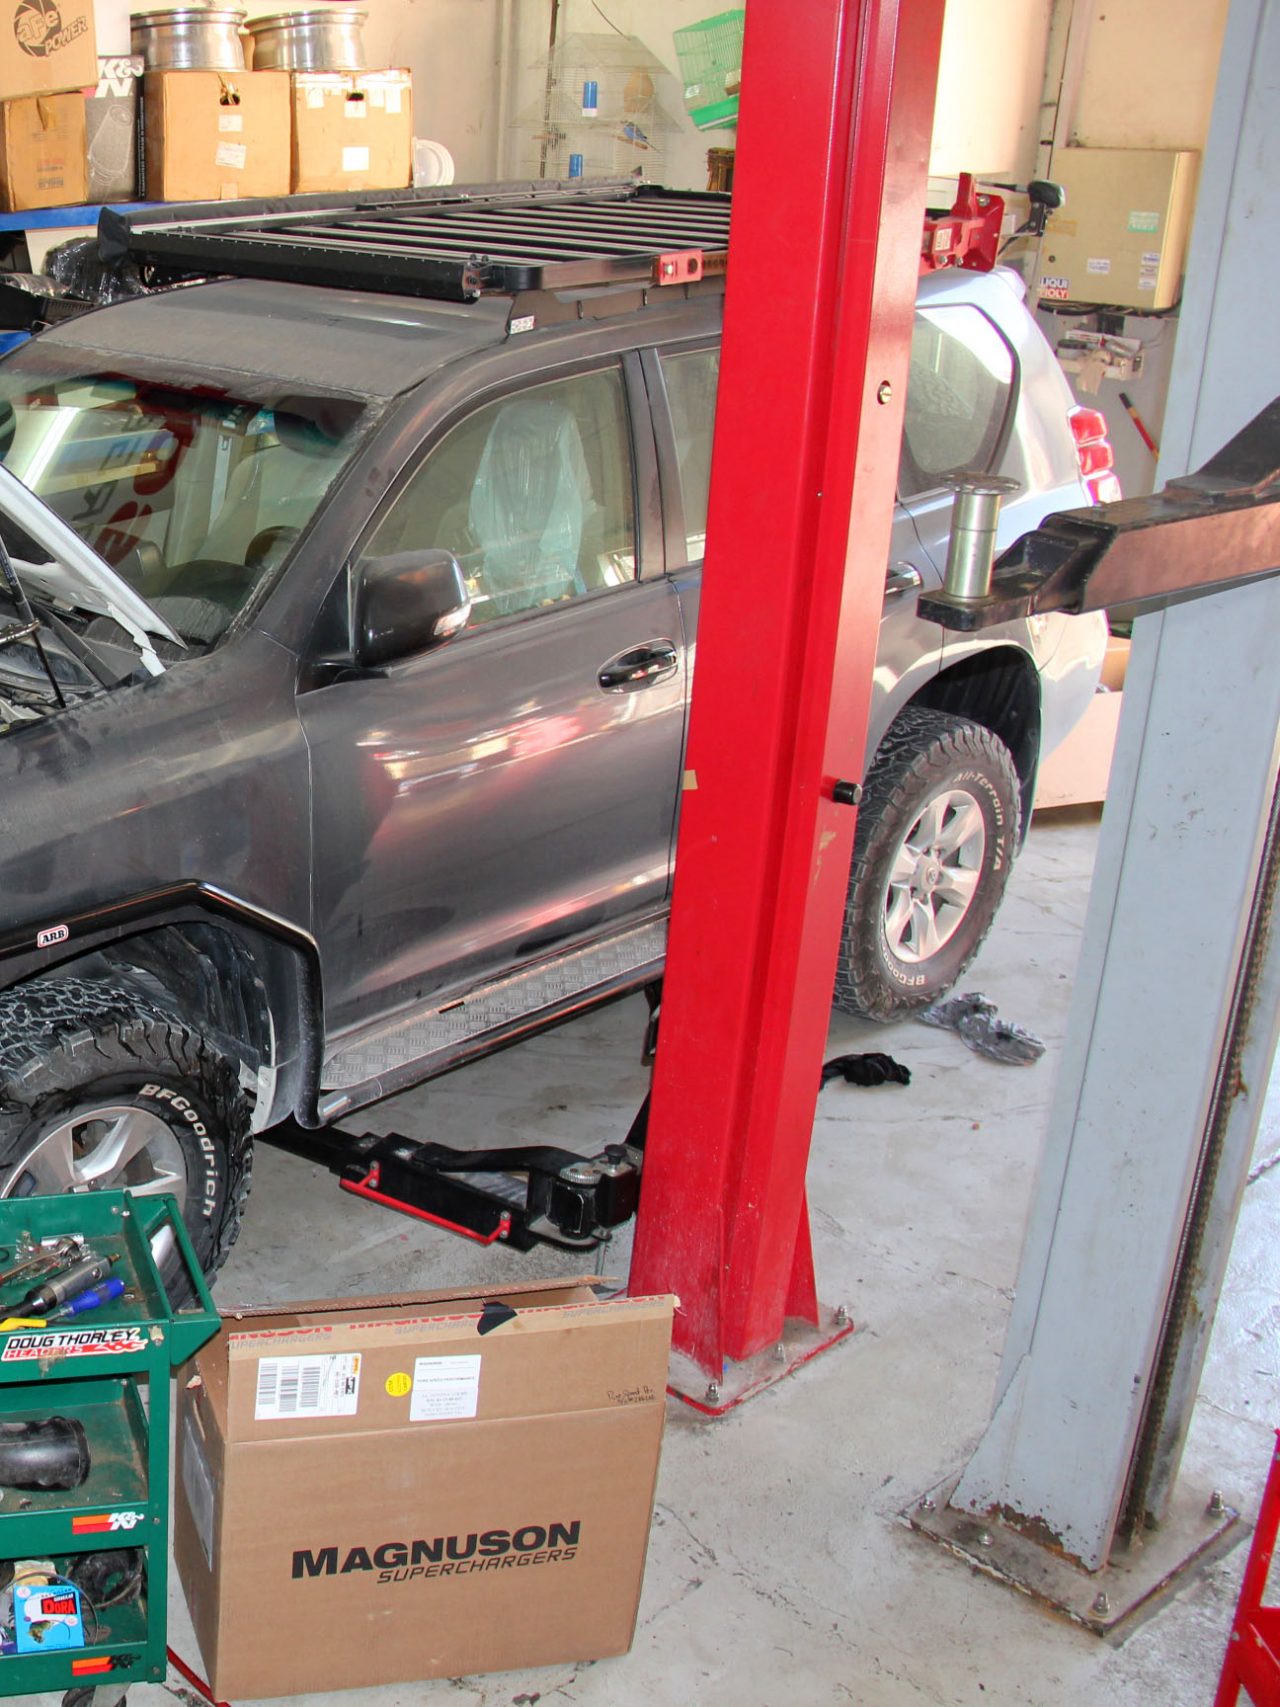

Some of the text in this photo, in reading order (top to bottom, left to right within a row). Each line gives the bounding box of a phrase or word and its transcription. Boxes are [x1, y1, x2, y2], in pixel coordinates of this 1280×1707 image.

[44, 16, 88, 56] POWER
[1040, 277, 1068, 288] LIQUI
[952, 772, 1005, 870] All-Terrain T/A
[41, 927, 66, 944] ARB
[139, 1083, 217, 1216] BFGoodrich
[8, 1329, 136, 1349] DOUG THORLEY
[228, 1333, 332, 1349] UPERCHARGERS
[108, 1511, 144, 1530] K&N
[292, 1520, 581, 1579] MAGNUSON
[377, 1547, 578, 1584] SUPERCHARGERS
